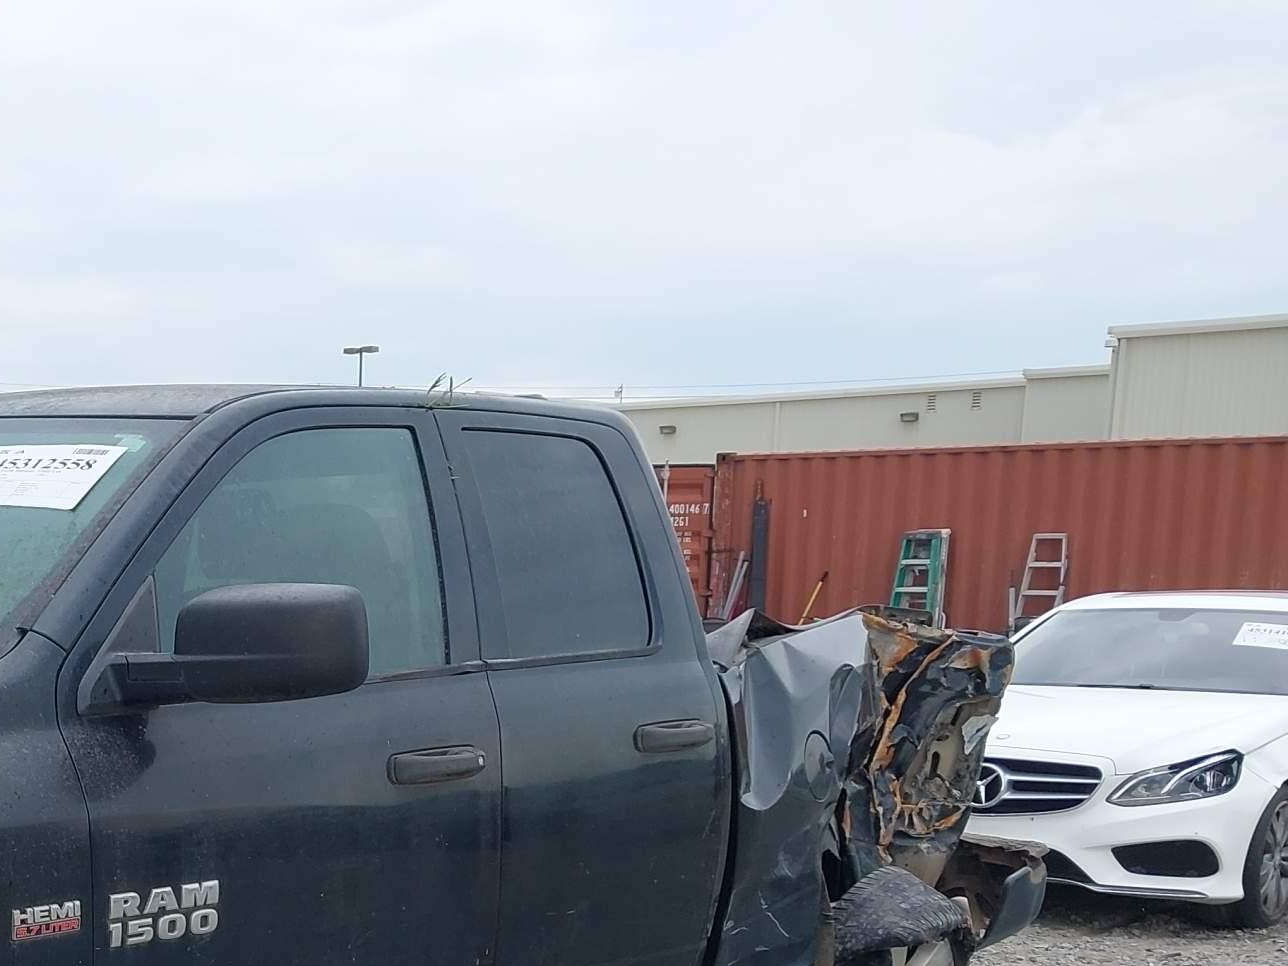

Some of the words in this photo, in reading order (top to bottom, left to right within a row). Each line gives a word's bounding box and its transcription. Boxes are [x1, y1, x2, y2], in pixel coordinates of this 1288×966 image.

[669, 503, 700, 514] 400146
[108, 880, 220, 919] RAM
[12, 900, 81, 926] HEMI
[16, 925, 41, 938] 5.7
[41, 918, 79, 934] LITER
[109, 908, 219, 948] 1500
